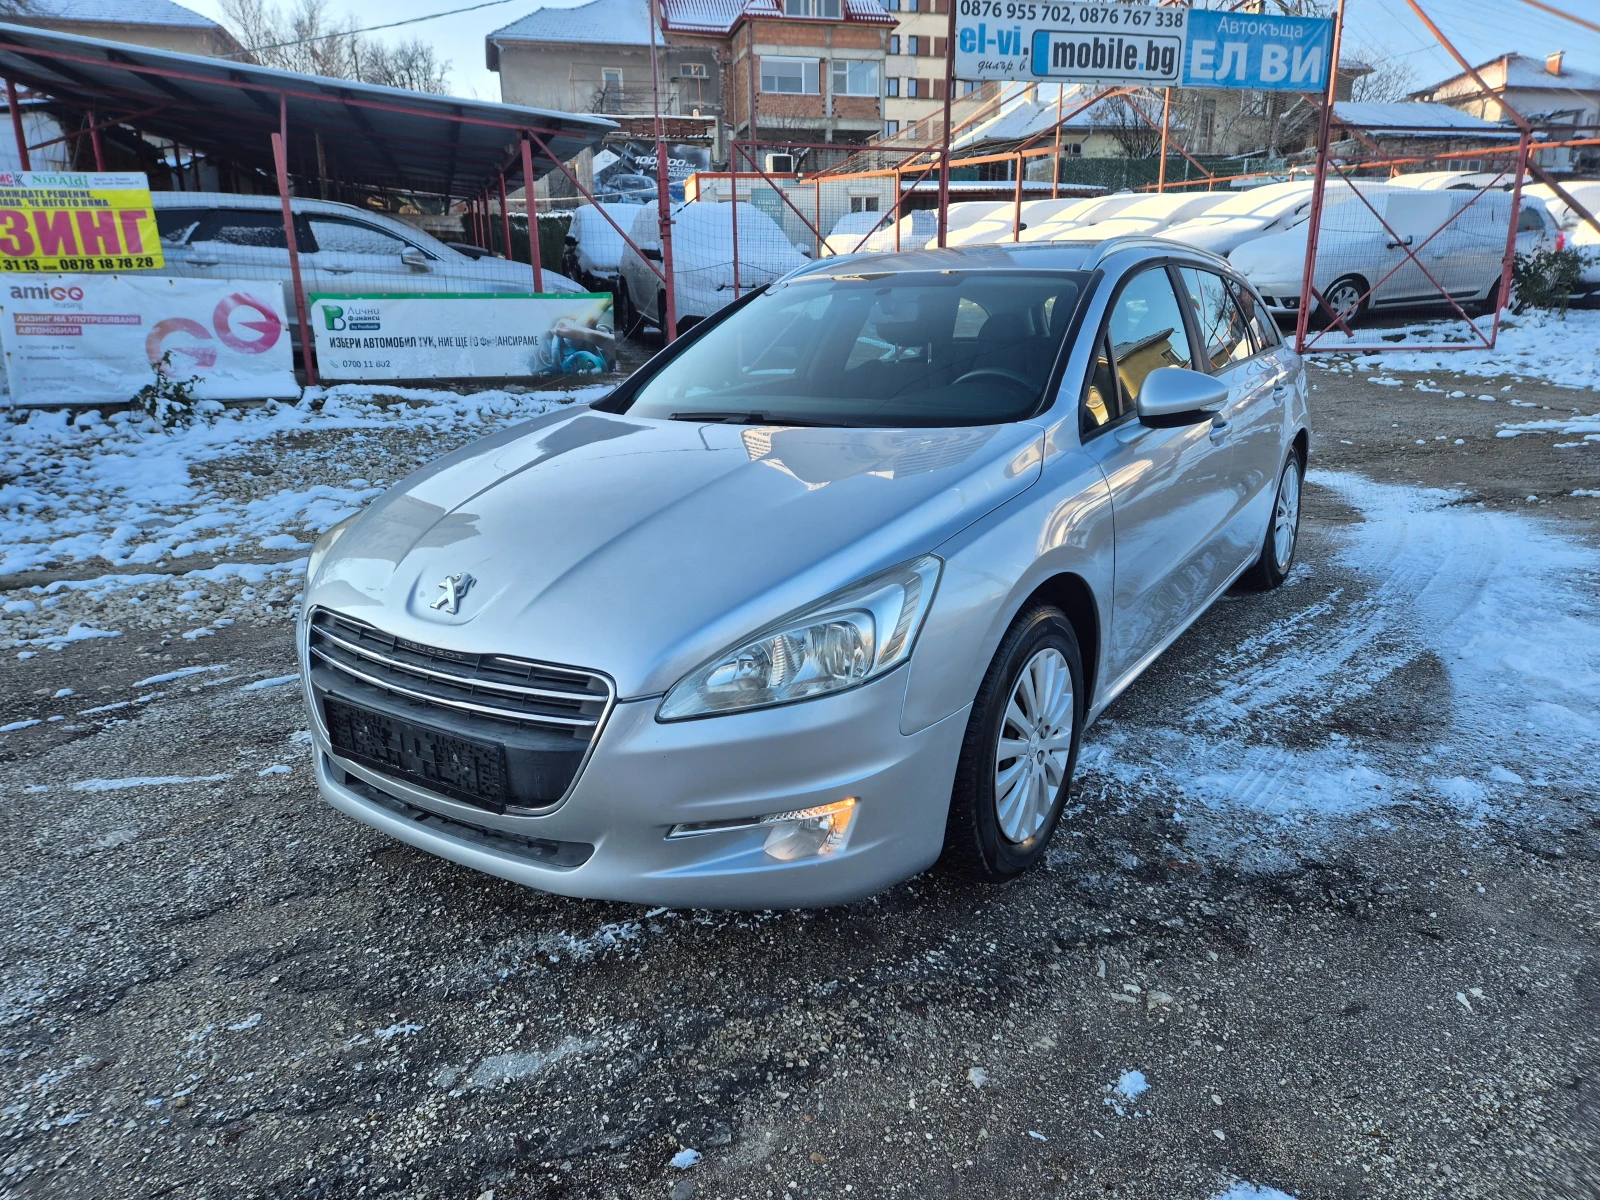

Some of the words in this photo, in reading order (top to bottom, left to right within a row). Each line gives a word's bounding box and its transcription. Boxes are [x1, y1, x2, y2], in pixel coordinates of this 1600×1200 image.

[960, 0, 1002, 18] 0876
[1006, 3, 1037, 21] 955
[1041, 5, 1075, 25] 702,
[1080, 7, 1119, 25] 0876
[1123, 9, 1152, 26] 767
[1155, 12, 1184, 28] 338
[1217, 15, 1304, 40] Автокъща
[1052, 36, 1176, 76] mobile.bg
[1189, 39, 1248, 81] ЕЛ
[1259, 43, 1322, 84] ВИ
[977, 60, 1014, 74] дилър
[1018, 57, 1028, 72] в
[634, 155, 686, 167] 10000
[667, 165, 703, 173] NCLUSIVE
[46, 189, 95, 199] РЕШЕНИЕ.
[27, 198, 41, 208] ЧЕ
[42, 198, 66, 207] НЕГО
[67, 199, 80, 207] ГО
[80, 199, 112, 208] НЯМА.
[0, 209, 148, 257] ЗИНГ
[2, 259, 21, 271] 31
[22, 259, 40, 271] 13
[59, 258, 96, 270] 0878
[98, 258, 115, 269] 18
[117, 257, 134, 269] 78
[135, 256, 154, 268] 28
[53, 301, 84, 311] leasing
[347, 306, 380, 315] Лични
[17, 315, 53, 323] ЛИЗИНГ
[54, 315, 66, 323] НА
[66, 315, 139, 324] УПОТРЕБЯВАНИ
[18, 326, 80, 335] АВТОМОБИЛИ
[329, 336, 362, 349] ИЗБЕРИ
[363, 336, 417, 349] АВТОМОБИЛ
[418, 336, 437, 349] ТУК,
[438, 336, 454, 348] НИЕ
[455, 336, 468, 349] ЩЕ
[342, 360, 362, 368] 0700
[363, 360, 373, 368] 11
[404, 640, 464, 660] PEUGEOT
